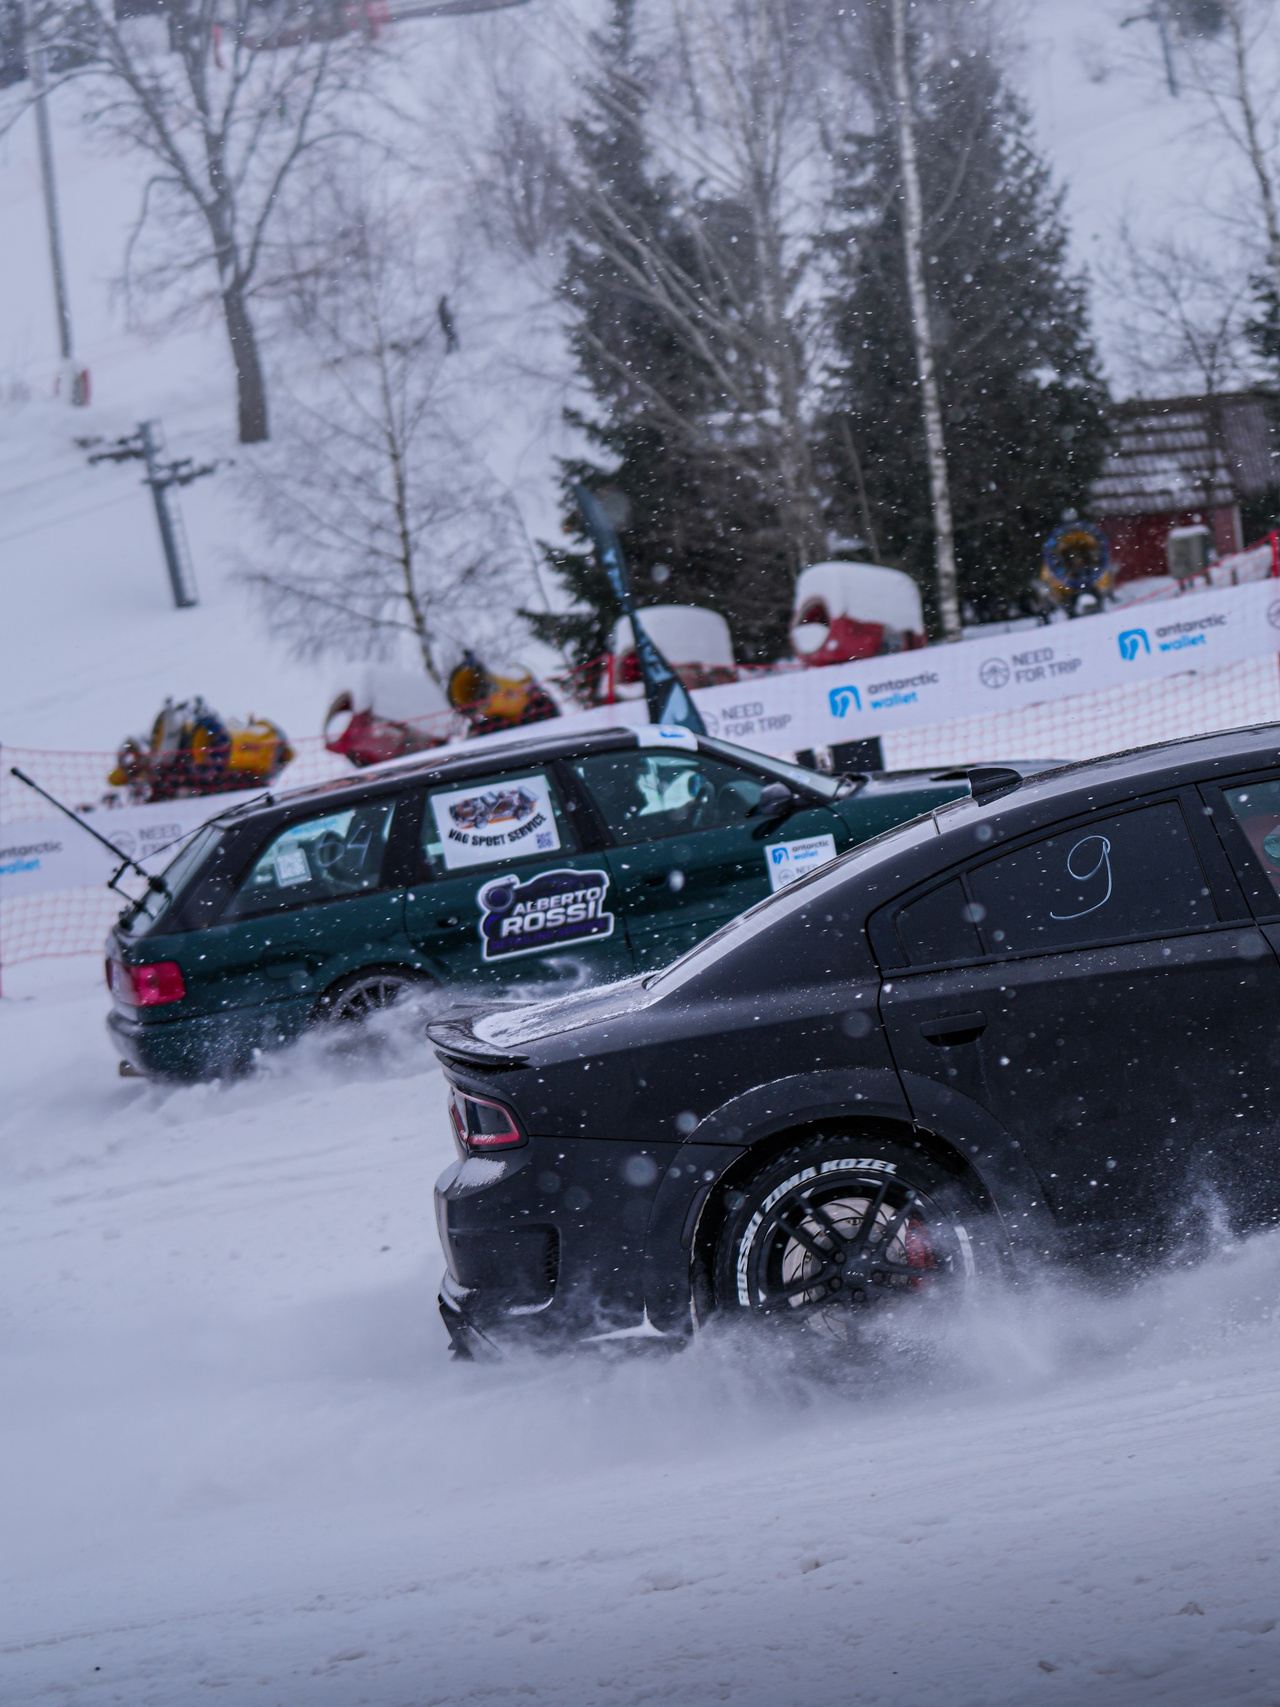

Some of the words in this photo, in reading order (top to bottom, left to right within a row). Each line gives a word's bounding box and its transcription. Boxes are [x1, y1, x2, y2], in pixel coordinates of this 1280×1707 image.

[1155, 613, 1227, 638] antarctic
[1159, 634, 1206, 652] wallet
[1012, 647, 1054, 667] NEED
[1015, 665, 1047, 684] FOR
[1048, 658, 1082, 676] TRIP
[867, 671, 940, 696] antarctic
[722, 702, 764, 720] NEED
[870, 691, 918, 710] wallet
[725, 719, 757, 737] FOR
[758, 713, 792, 731] TRIP
[448, 828, 470, 844] VAG
[471, 834, 506, 847] SPORT
[507, 813, 547, 842] SERVICE
[0, 841, 62, 860] ntarctic
[792, 840, 829, 852] antarctic
[793, 850, 818, 860] wallet
[512, 887, 601, 916] ALBERTO
[501, 901, 596, 937] ROSSI
[737, 1211, 764, 1307] RUSSKI
[761, 1166, 818, 1213] ZIMA
[820, 1158, 898, 1175] KOZEL
